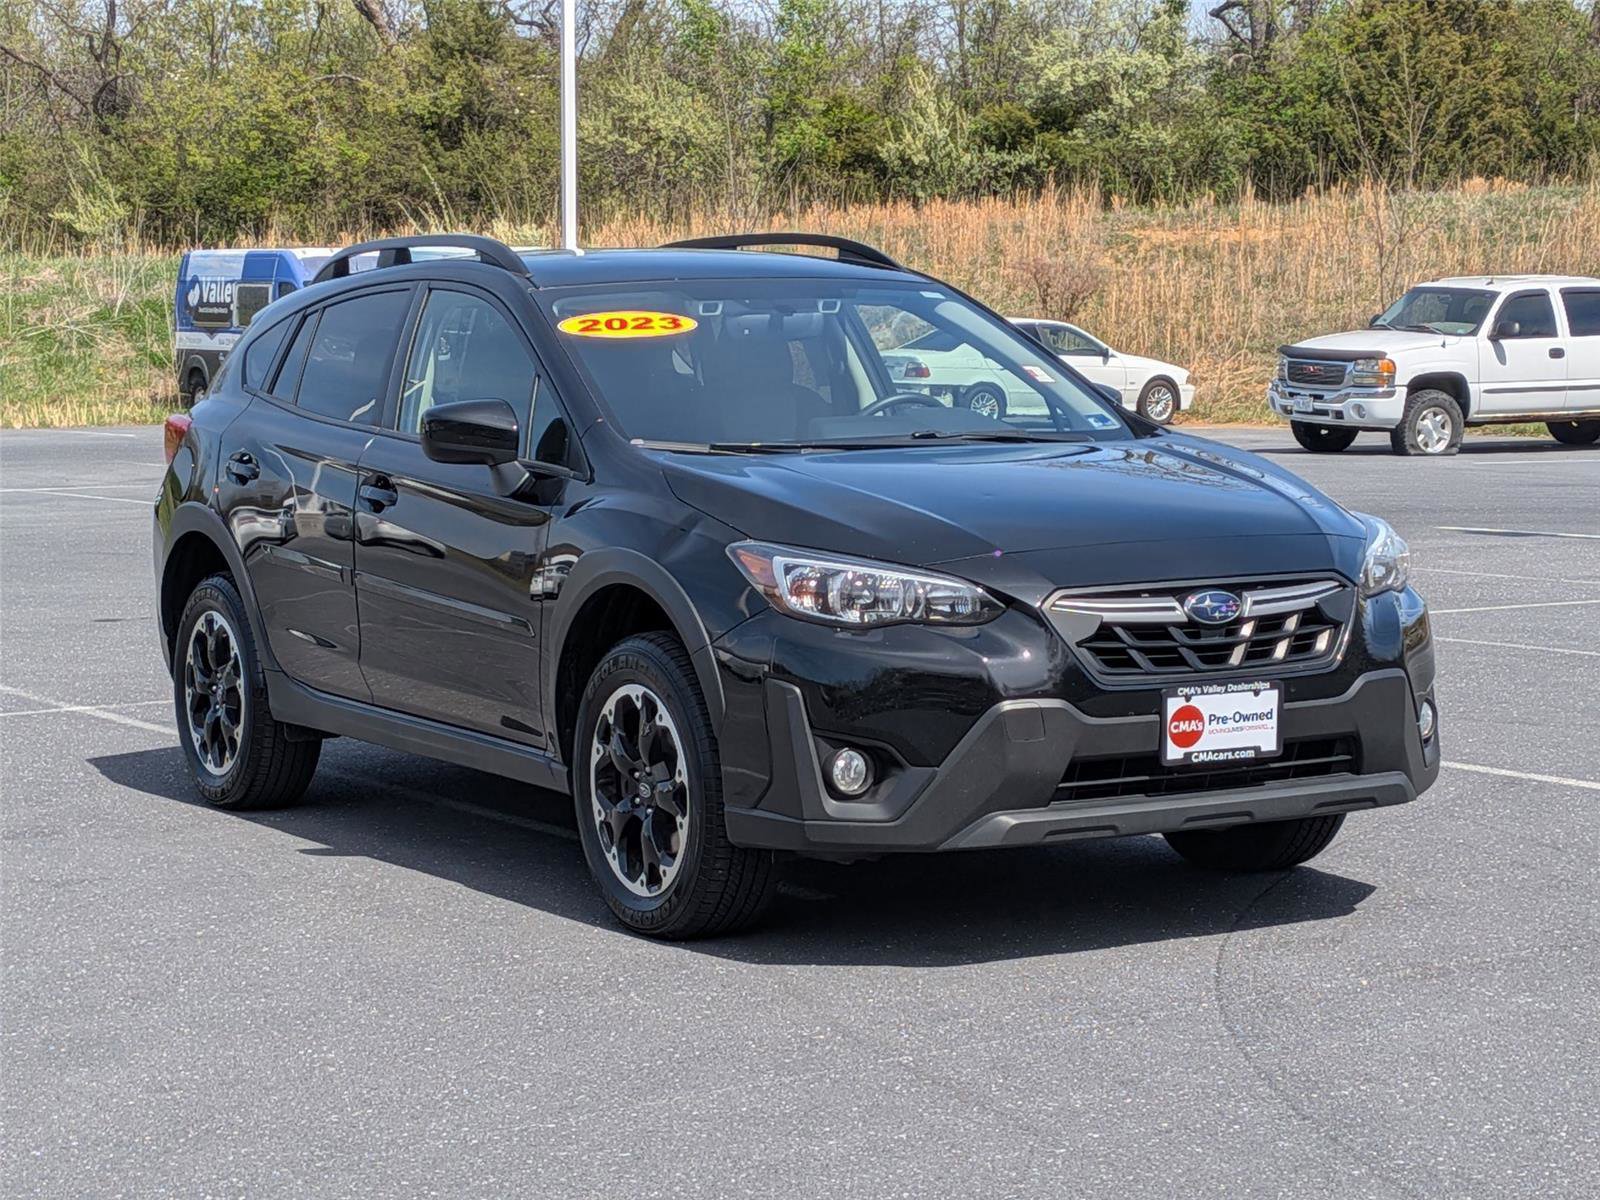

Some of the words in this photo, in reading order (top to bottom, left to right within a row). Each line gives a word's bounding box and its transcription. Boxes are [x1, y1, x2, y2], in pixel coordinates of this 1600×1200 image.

[577, 316, 683, 333] 2023
[1177, 685, 1201, 696] CMA's
[1202, 684, 1226, 694] Valley
[1227, 681, 1270, 692] Dealerships
[1208, 708, 1274, 726] Pre-Owned
[1170, 719, 1204, 734] CMA's
[1191, 749, 1255, 763] CMAcars.com
